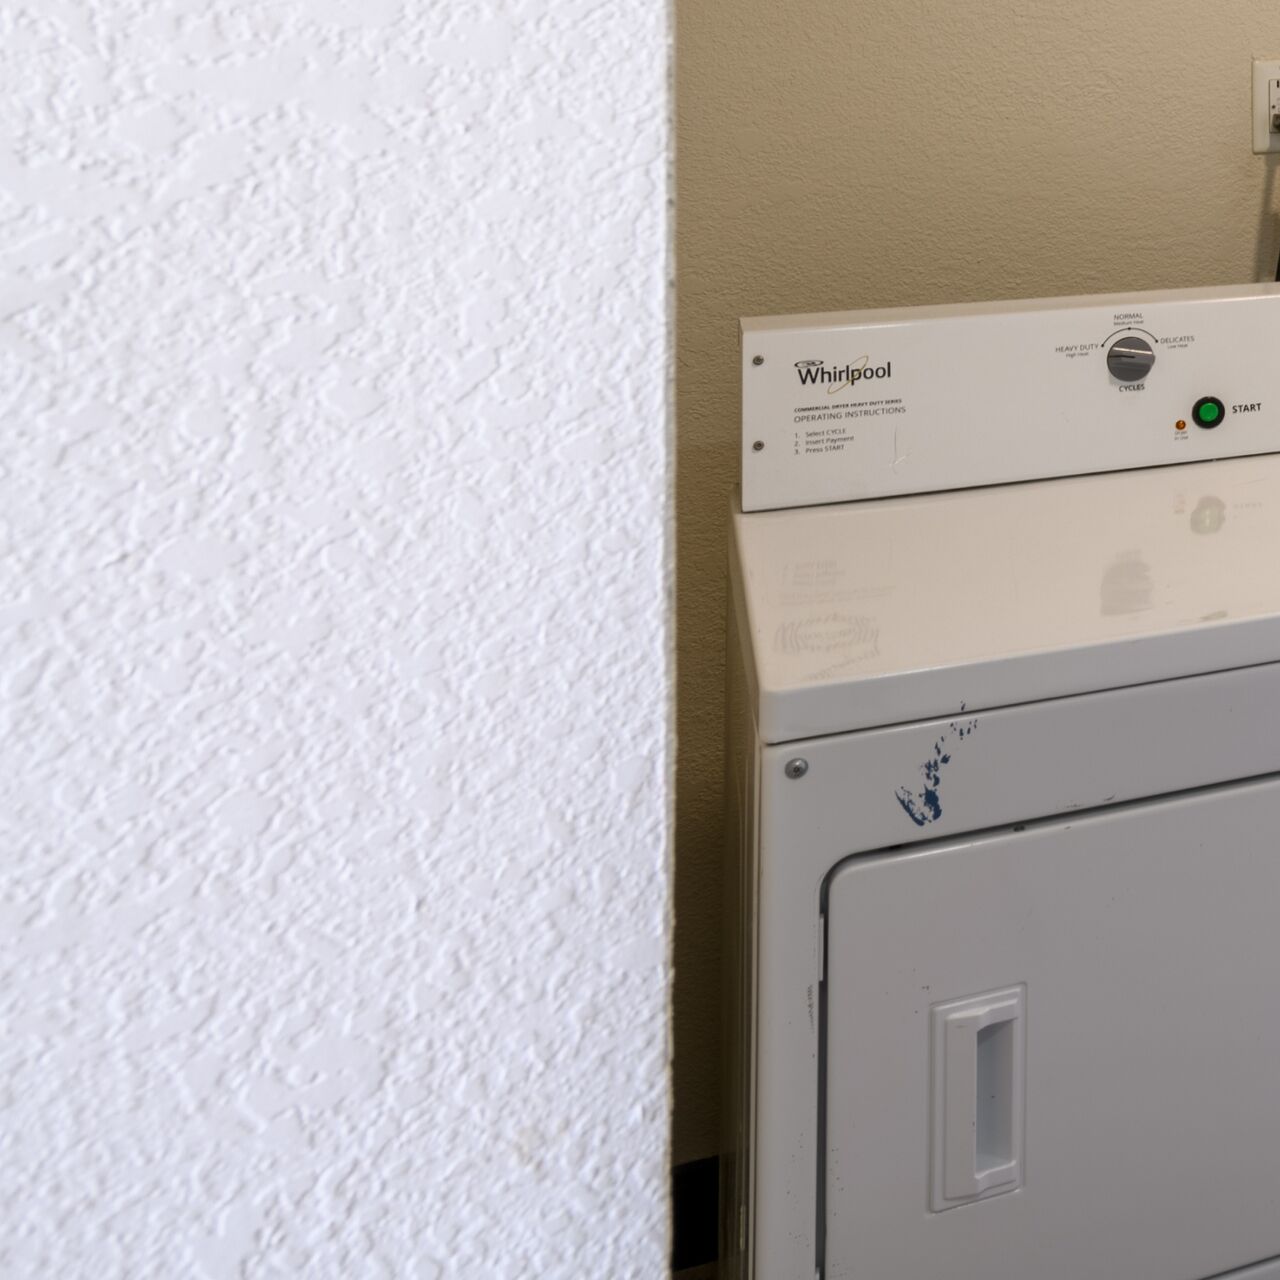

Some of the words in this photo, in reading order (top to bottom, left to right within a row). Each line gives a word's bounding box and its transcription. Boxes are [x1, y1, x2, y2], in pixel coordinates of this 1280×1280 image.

[1114, 312, 1144, 321] NORMAL
[1160, 335, 1196, 344] DELICATES
[1056, 344, 1079, 353] HEAVY
[1080, 343, 1099, 352] DUTY
[798, 361, 892, 386] Whirlpool
[1118, 383, 1146, 392] CYCLES
[794, 405, 830, 413] COMMERCIAL
[1232, 402, 1262, 414] START
[794, 411, 843, 424] OPERATING
[844, 406, 907, 418] INSTRUCTIONS
[805, 429, 825, 438] Select
[826, 428, 846, 436] CYCLE
[805, 438, 825, 446] Insert
[826, 434, 855, 445] Payment
[805, 446, 824, 454] Press
[824, 444, 845, 452] START
